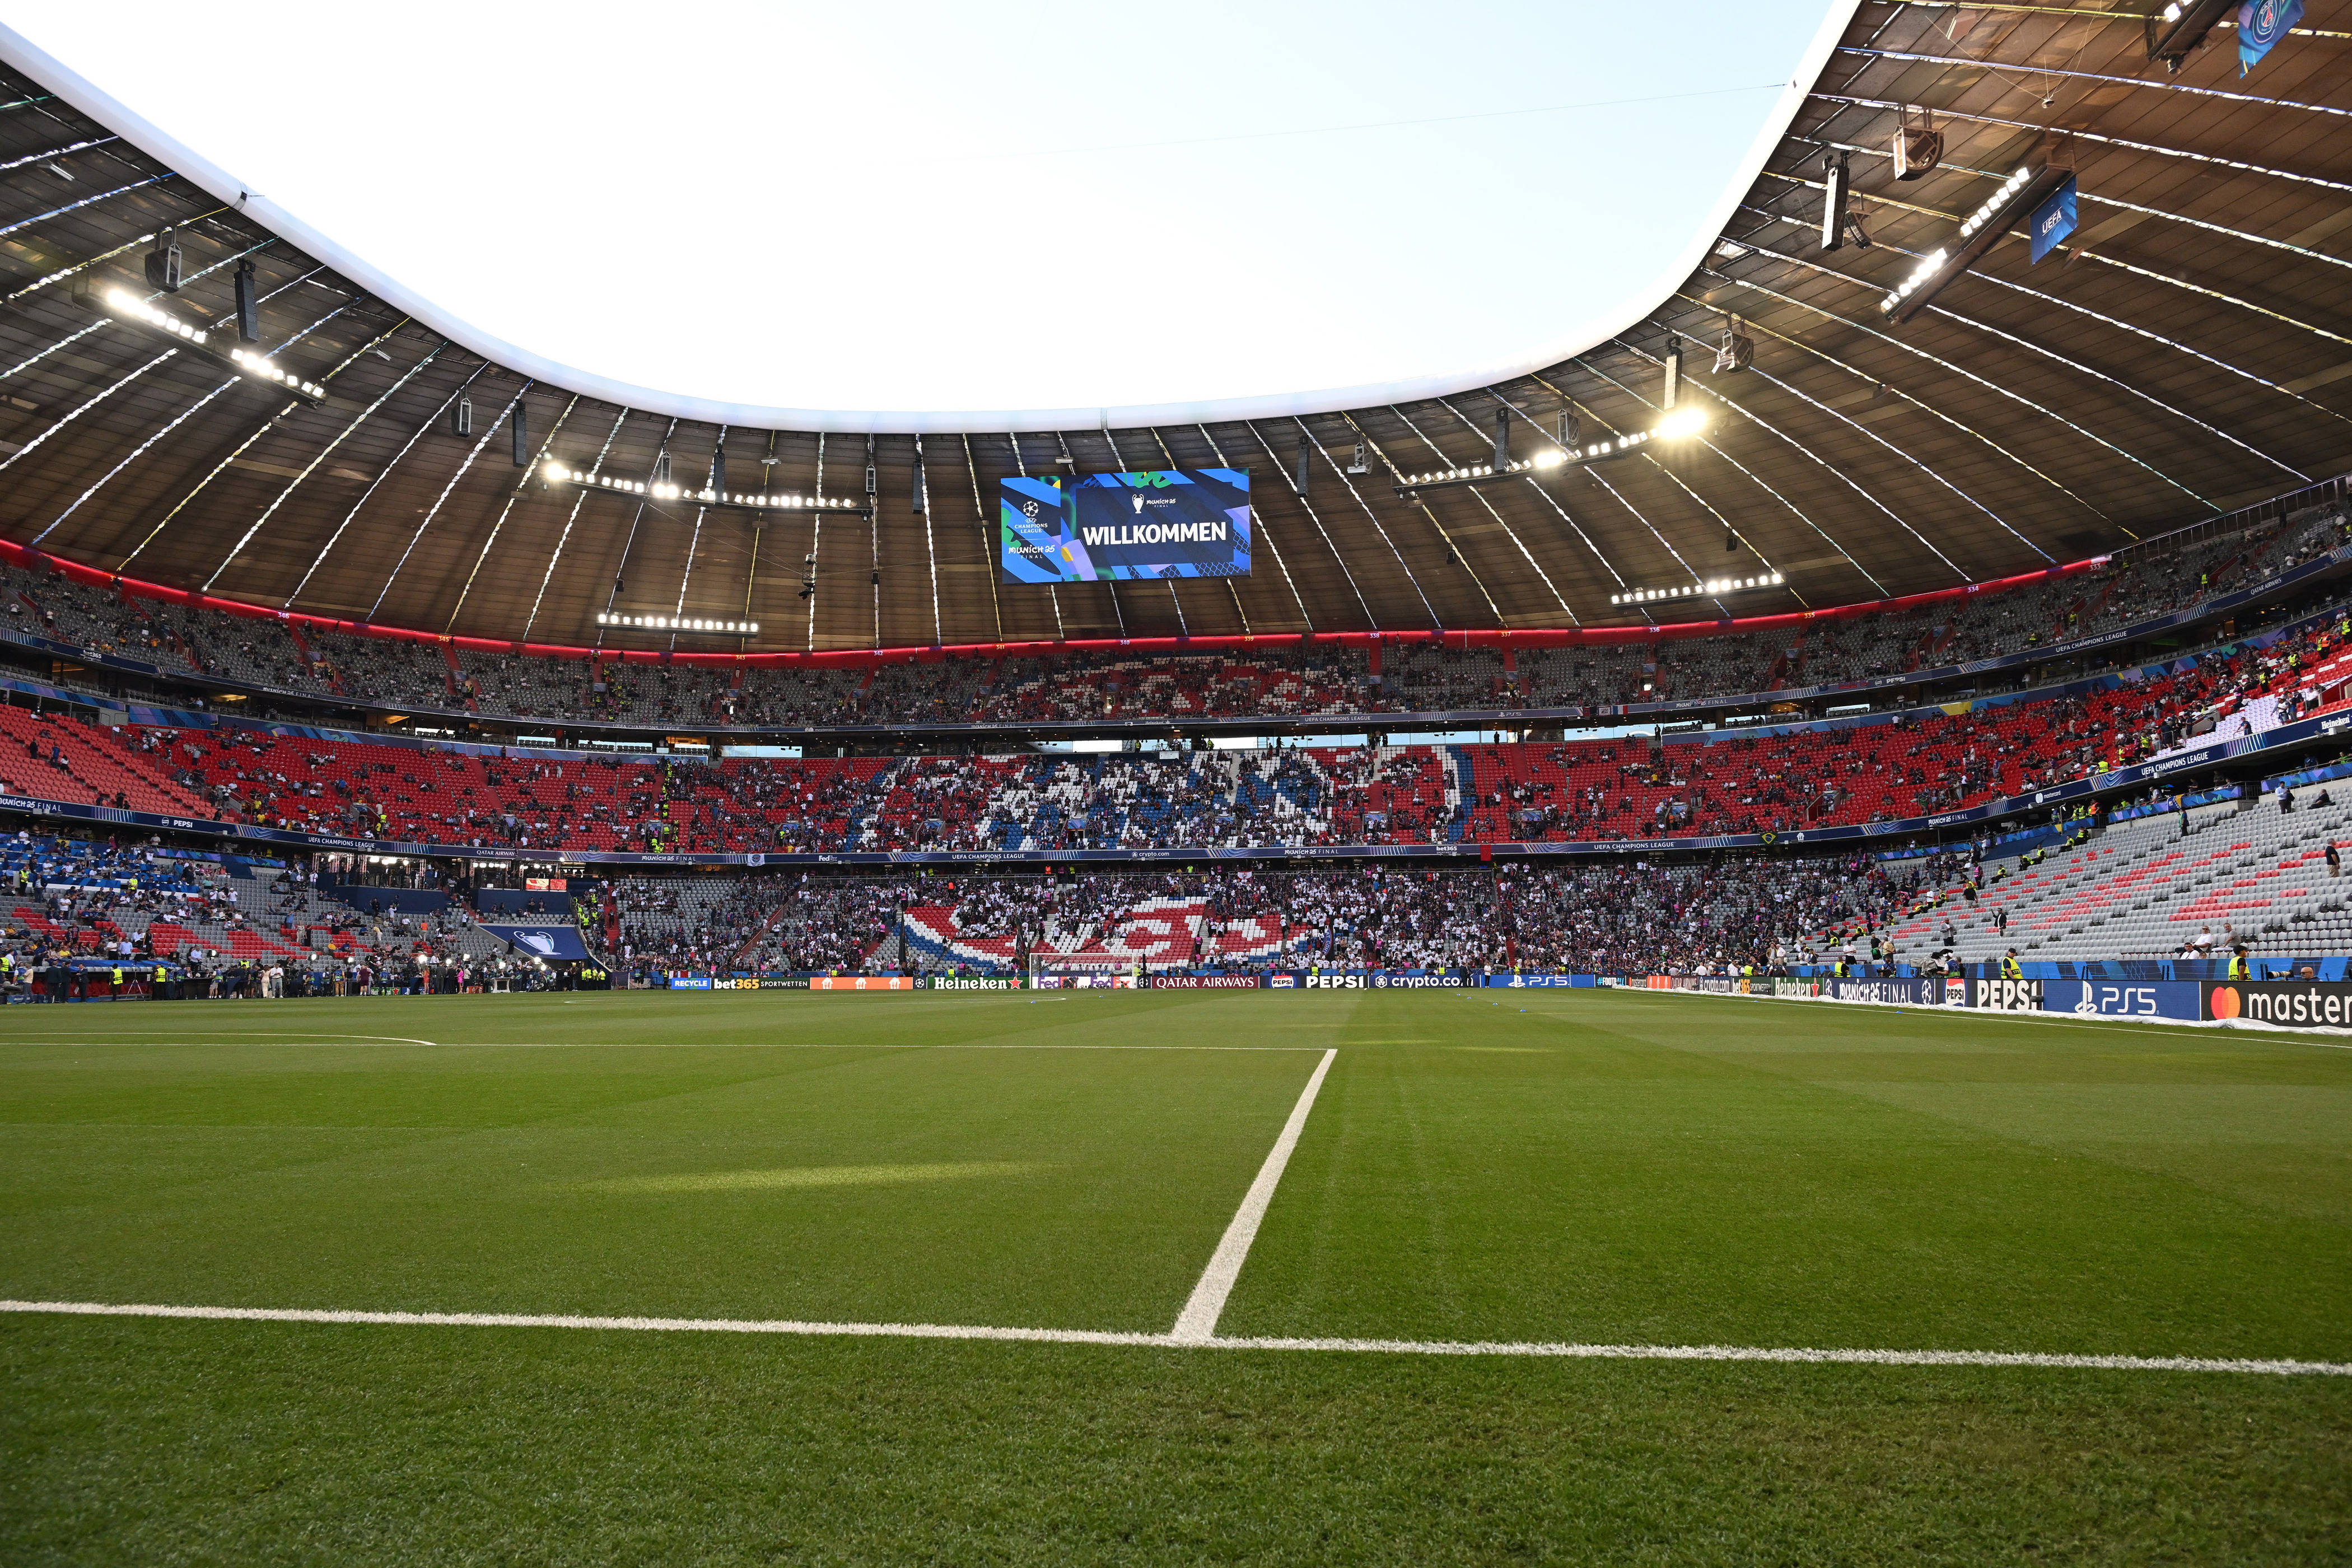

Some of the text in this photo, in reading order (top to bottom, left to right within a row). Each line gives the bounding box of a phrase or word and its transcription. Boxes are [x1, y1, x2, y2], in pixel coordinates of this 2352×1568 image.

[2042, 210, 2062, 234] UEFA
[1082, 522, 1226, 545] WILLKOMMEN
[2089, 563, 2101, 571] 333
[2251, 578, 2282, 595] QATAR AIRWAYS
[2071, 637, 2104, 648] CHAMPIONS
[2105, 631, 2127, 641] LEAGUE
[2321, 717, 2350, 730] Heineken
[2141, 752, 2209, 776] UEFA CHAMPIONS LEAGUE
[38, 802, 62, 811] FINAL
[321, 838, 353, 847] CHAMPIONS
[714, 979, 759, 989] bet365
[934, 977, 1007, 990] Heineken
[1156, 977, 1254, 988] QATAR AIRWAYS
[1306, 976, 1364, 988] PEPSI
[1529, 977, 1568, 986] PS5
[1671, 978, 1682, 990] QATAR
[1704, 978, 1729, 993] crypto.com
[1733, 978, 1751, 994] bet365
[1775, 977, 1810, 997] Heineken
[1870, 982, 1880, 1001] 25
[1883, 984, 1912, 1003] FINAL
[1947, 989, 1964, 1000] PEPSI
[1977, 980, 2037, 1011] PEPSI
[2102, 987, 2156, 1015] PS5
[2248, 987, 2352, 1024] master
